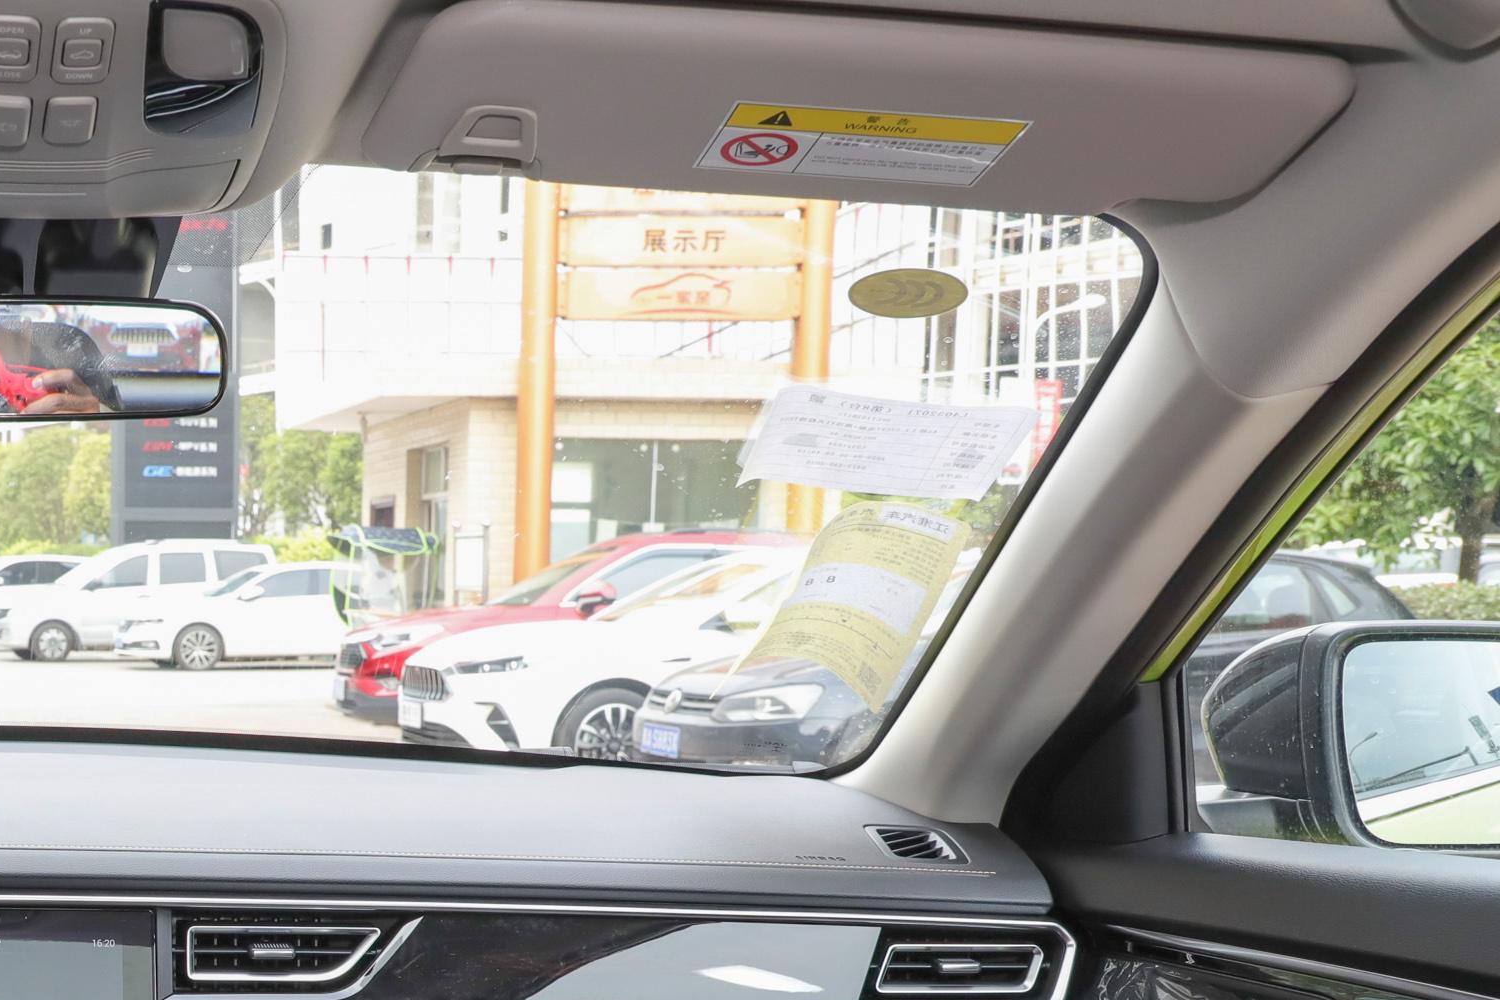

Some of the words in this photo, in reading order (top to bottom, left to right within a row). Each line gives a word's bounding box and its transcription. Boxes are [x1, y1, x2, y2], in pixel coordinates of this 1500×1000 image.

[844, 122, 918, 135] WARNING
[643, 229, 727, 253] 展示厅
[92, 938, 116, 948] 16:20
